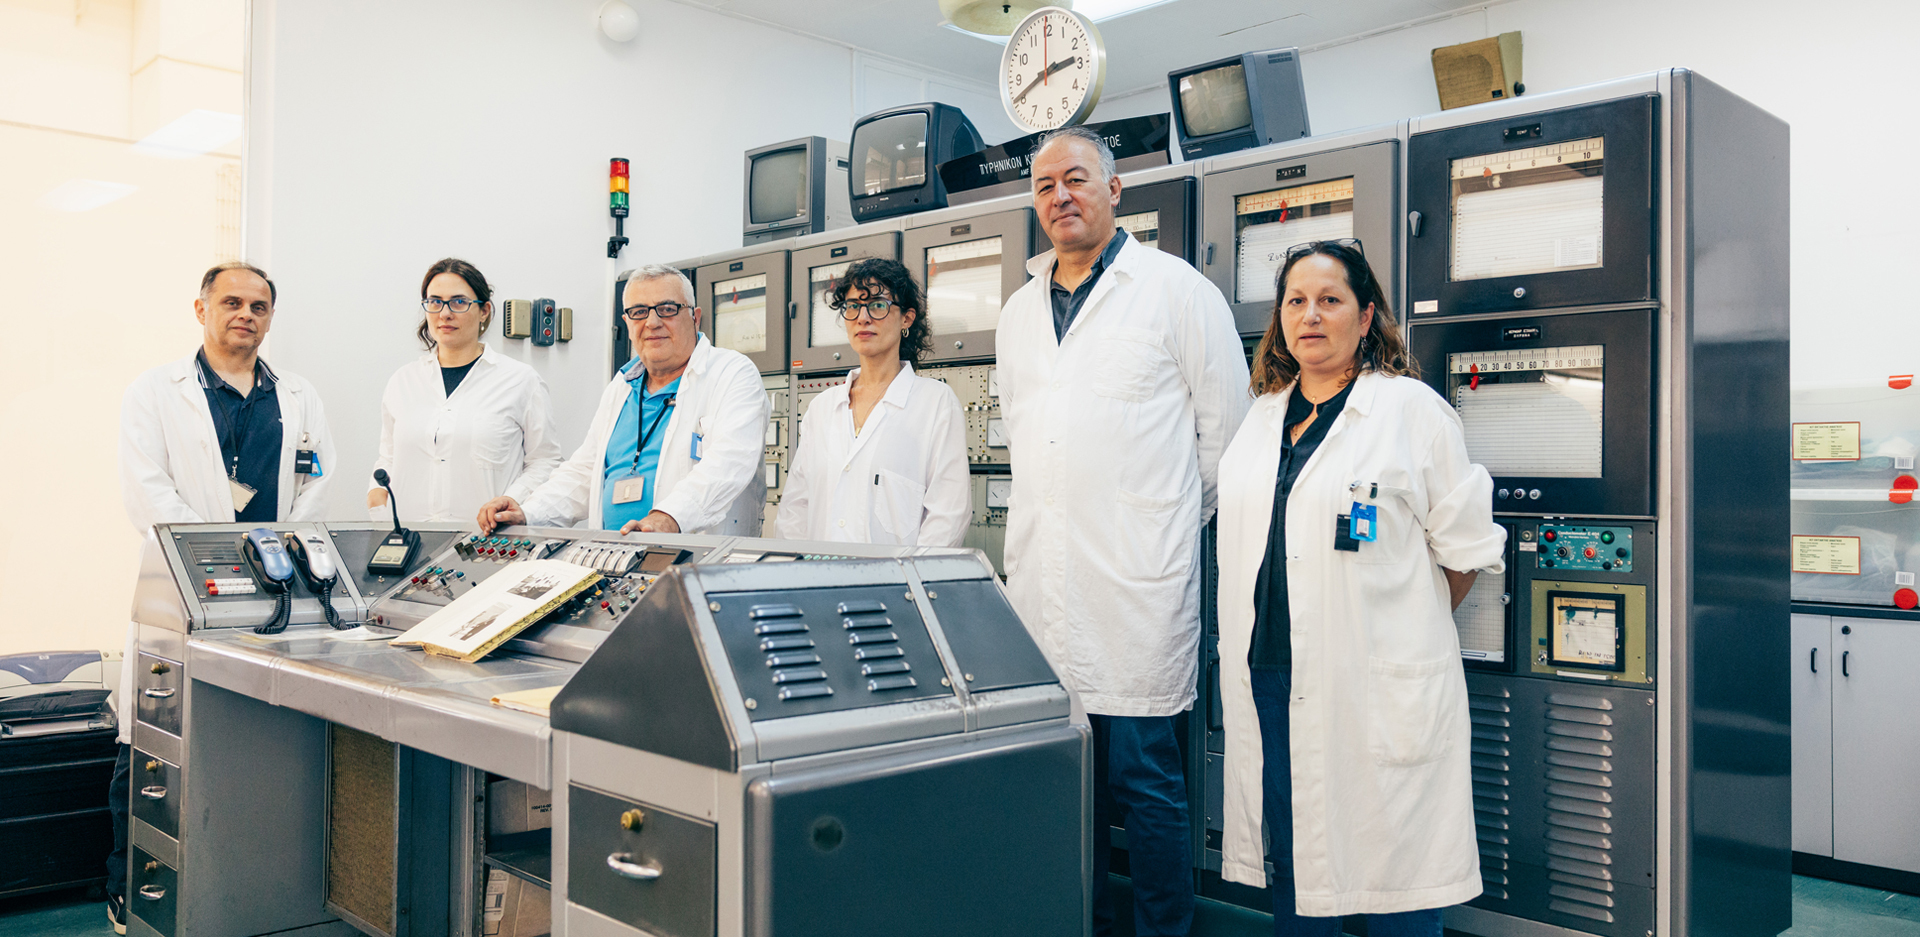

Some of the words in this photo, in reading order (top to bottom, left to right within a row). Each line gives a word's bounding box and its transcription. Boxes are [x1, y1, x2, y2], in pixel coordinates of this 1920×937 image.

[1061, 26, 1065, 38] 1
[1030, 34, 1038, 48] 11
[1071, 37, 1079, 50] 2
[1019, 53, 1029, 66] 10
[1076, 56, 1084, 69] 3
[1015, 73, 1022, 86] 9
[1071, 78, 1079, 91] 4
[1061, 96, 1069, 110] 5
[1031, 104, 1038, 117] 7
[1046, 107, 1054, 120] 6
[1459, 169, 1464, 177] 0
[1531, 159, 1536, 167] 6
[1557, 155, 1562, 163] 8
[1583, 151, 1591, 160] 10
[1458, 365, 1463, 373] 0
[1480, 363, 1488, 371] 20
[1492, 362, 1500, 371] 30
[1503, 362, 1512, 370] 40
[1516, 361, 1525, 370] 50
[1528, 361, 1537, 369] 60
[1542, 360, 1550, 368] 70
[1554, 359, 1563, 368] 80
[1567, 359, 1576, 367] 90
[1580, 358, 1591, 367] 100
